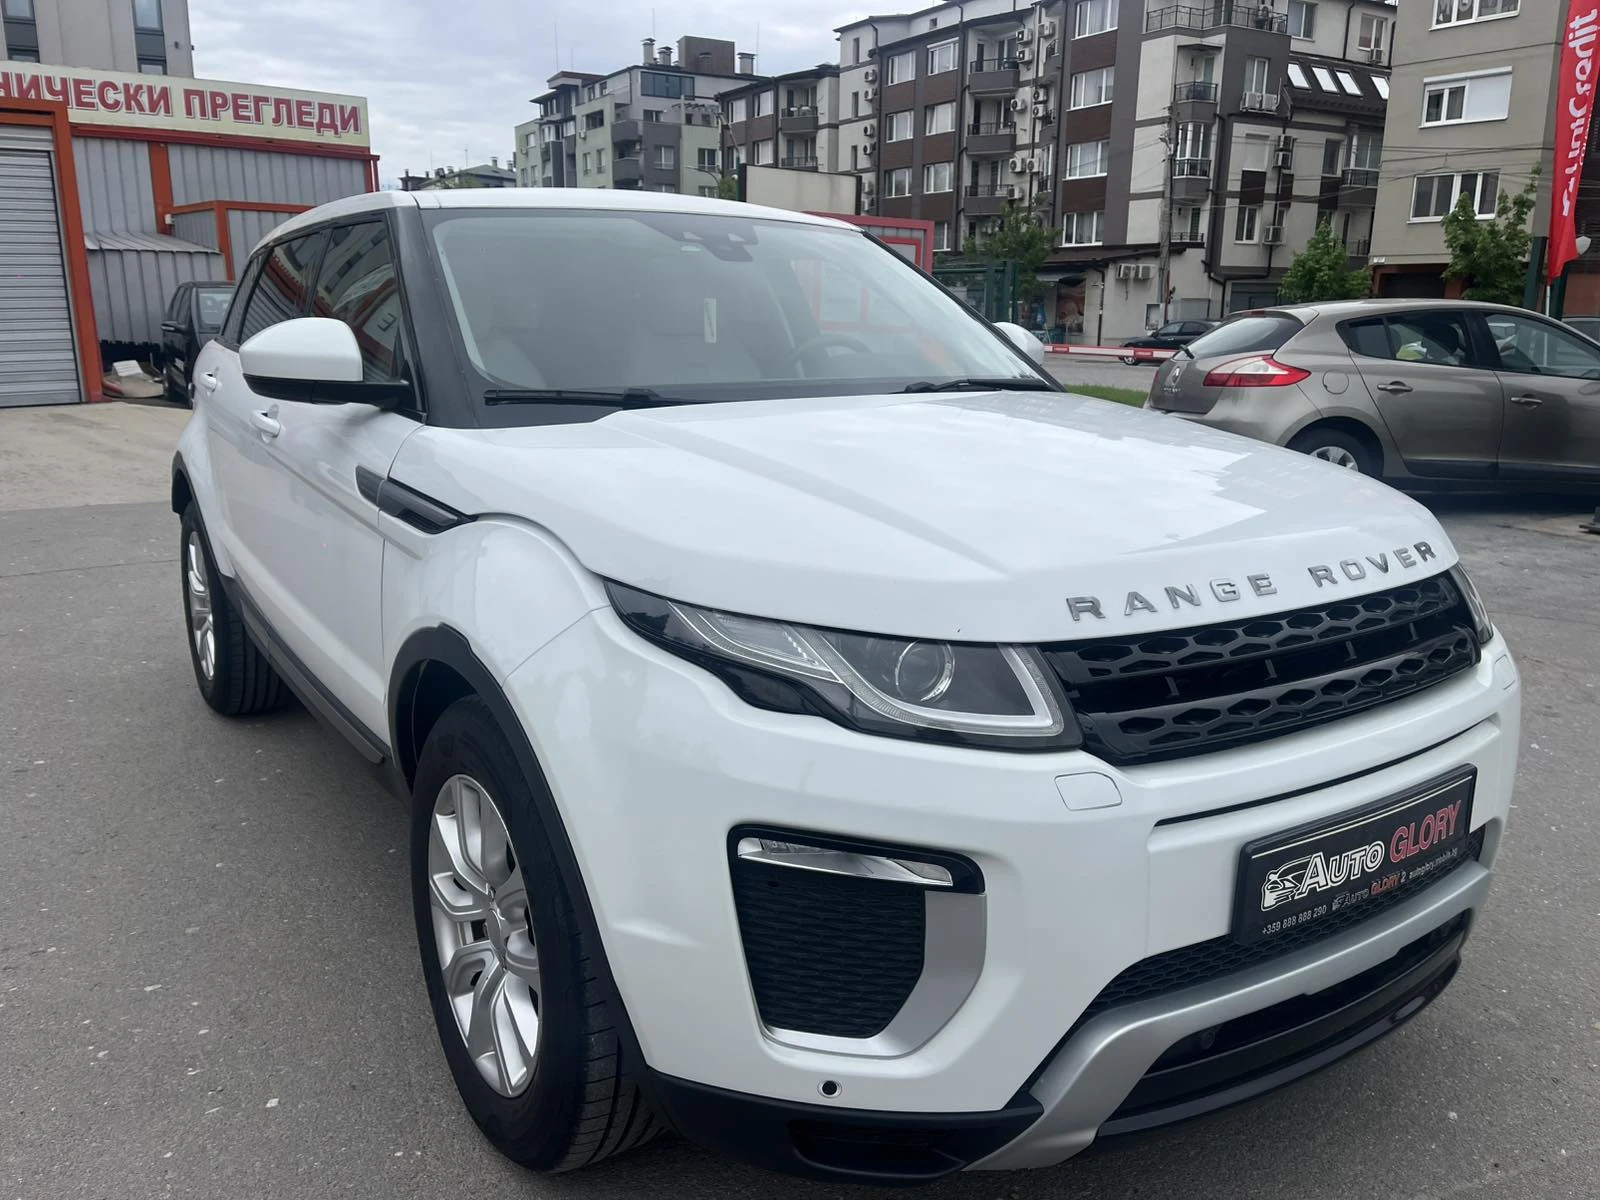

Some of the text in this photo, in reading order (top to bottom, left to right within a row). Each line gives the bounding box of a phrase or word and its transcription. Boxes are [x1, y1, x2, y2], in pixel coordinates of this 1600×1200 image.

[183, 88, 361, 136] ПРЕГЛЕДИ
[1065, 541, 1437, 621] RANGE ROVER
[1389, 800, 1462, 864] GLORY
[1261, 921, 1281, 935] +359
[1282, 915, 1297, 929] 888
[1298, 910, 1312, 923] 888
[1313, 904, 1327, 918] 290
[1370, 872, 1400, 896] GLORY
[1400, 870, 1407, 883] 2
